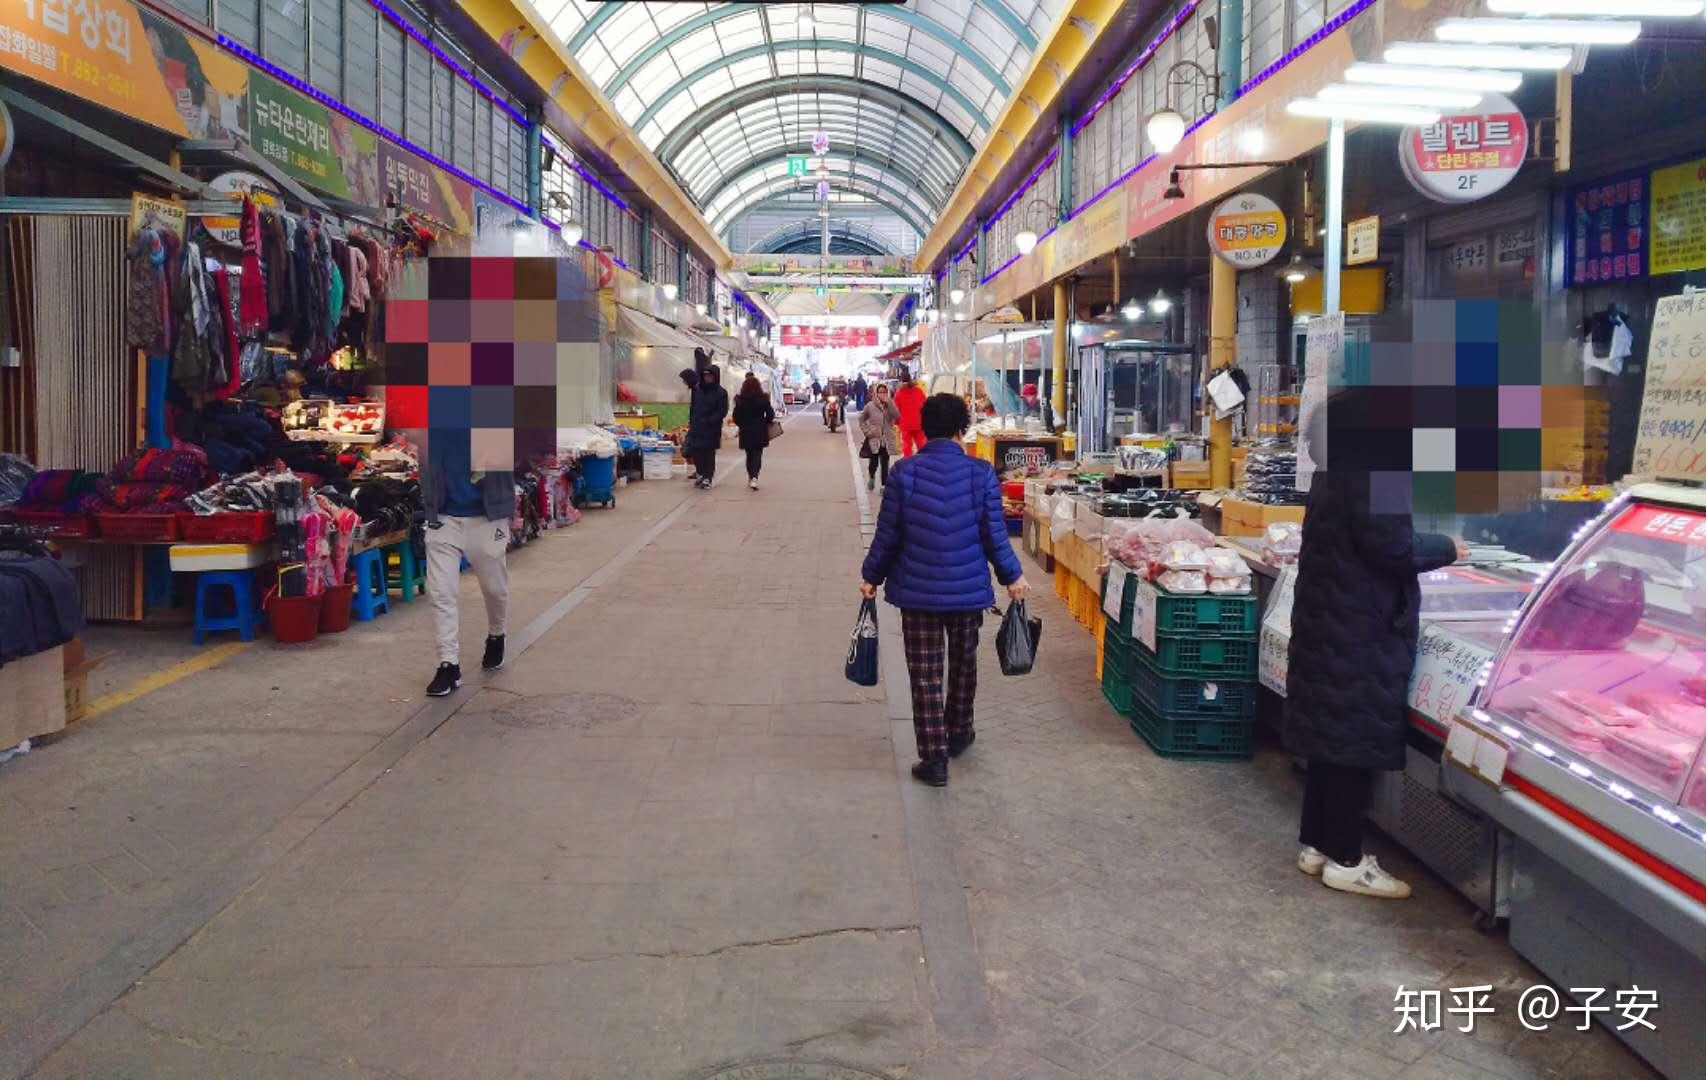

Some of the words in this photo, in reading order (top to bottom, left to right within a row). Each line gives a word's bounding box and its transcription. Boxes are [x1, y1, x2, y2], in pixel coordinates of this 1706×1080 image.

[1420, 119, 1513, 152] 탤렌트
[1437, 151, 1499, 169] 단란주점
[1458, 175, 1478, 190] 2F
[1235, 248, 1268, 260] NO.47
